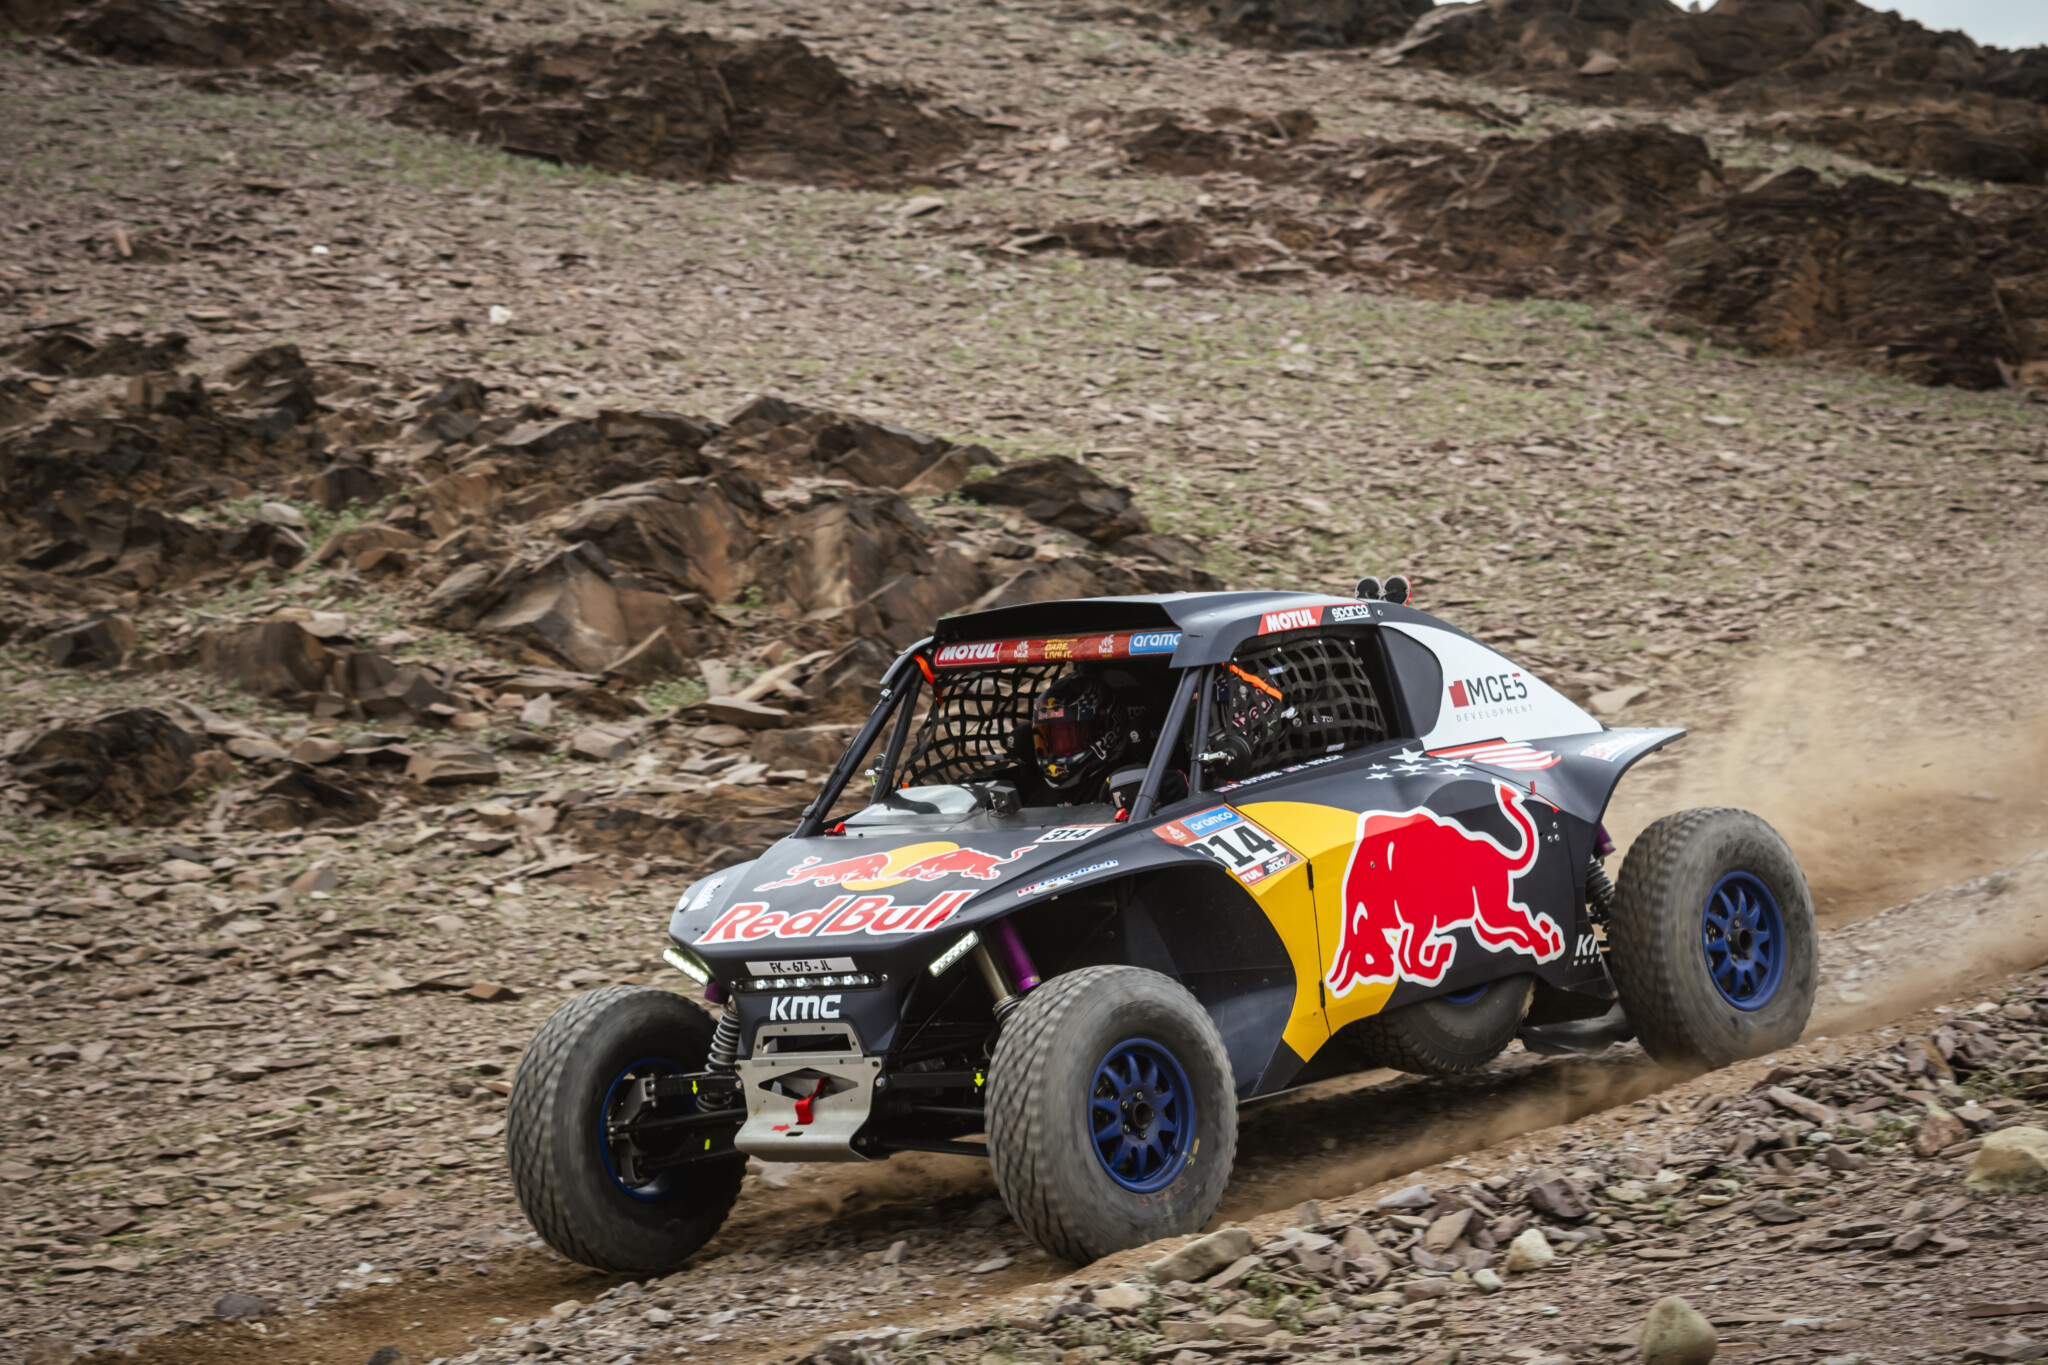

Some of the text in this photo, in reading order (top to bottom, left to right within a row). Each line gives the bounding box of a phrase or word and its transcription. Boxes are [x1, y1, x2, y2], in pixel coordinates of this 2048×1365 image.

[1265, 609, 1317, 633] MOTUL
[1331, 604, 1370, 621] sparco
[1133, 633, 1182, 648] aramc
[938, 642, 997, 661] MOTUL
[1465, 672, 1528, 706] MCE5
[1456, 704, 1534, 723] DEVELOPMENT
[1190, 811, 1233, 831] aramco
[1042, 828, 1094, 841] 314
[1265, 854, 1290, 874] 300V
[695, 890, 976, 944] Red Bull
[769, 994, 843, 1021] KMC
